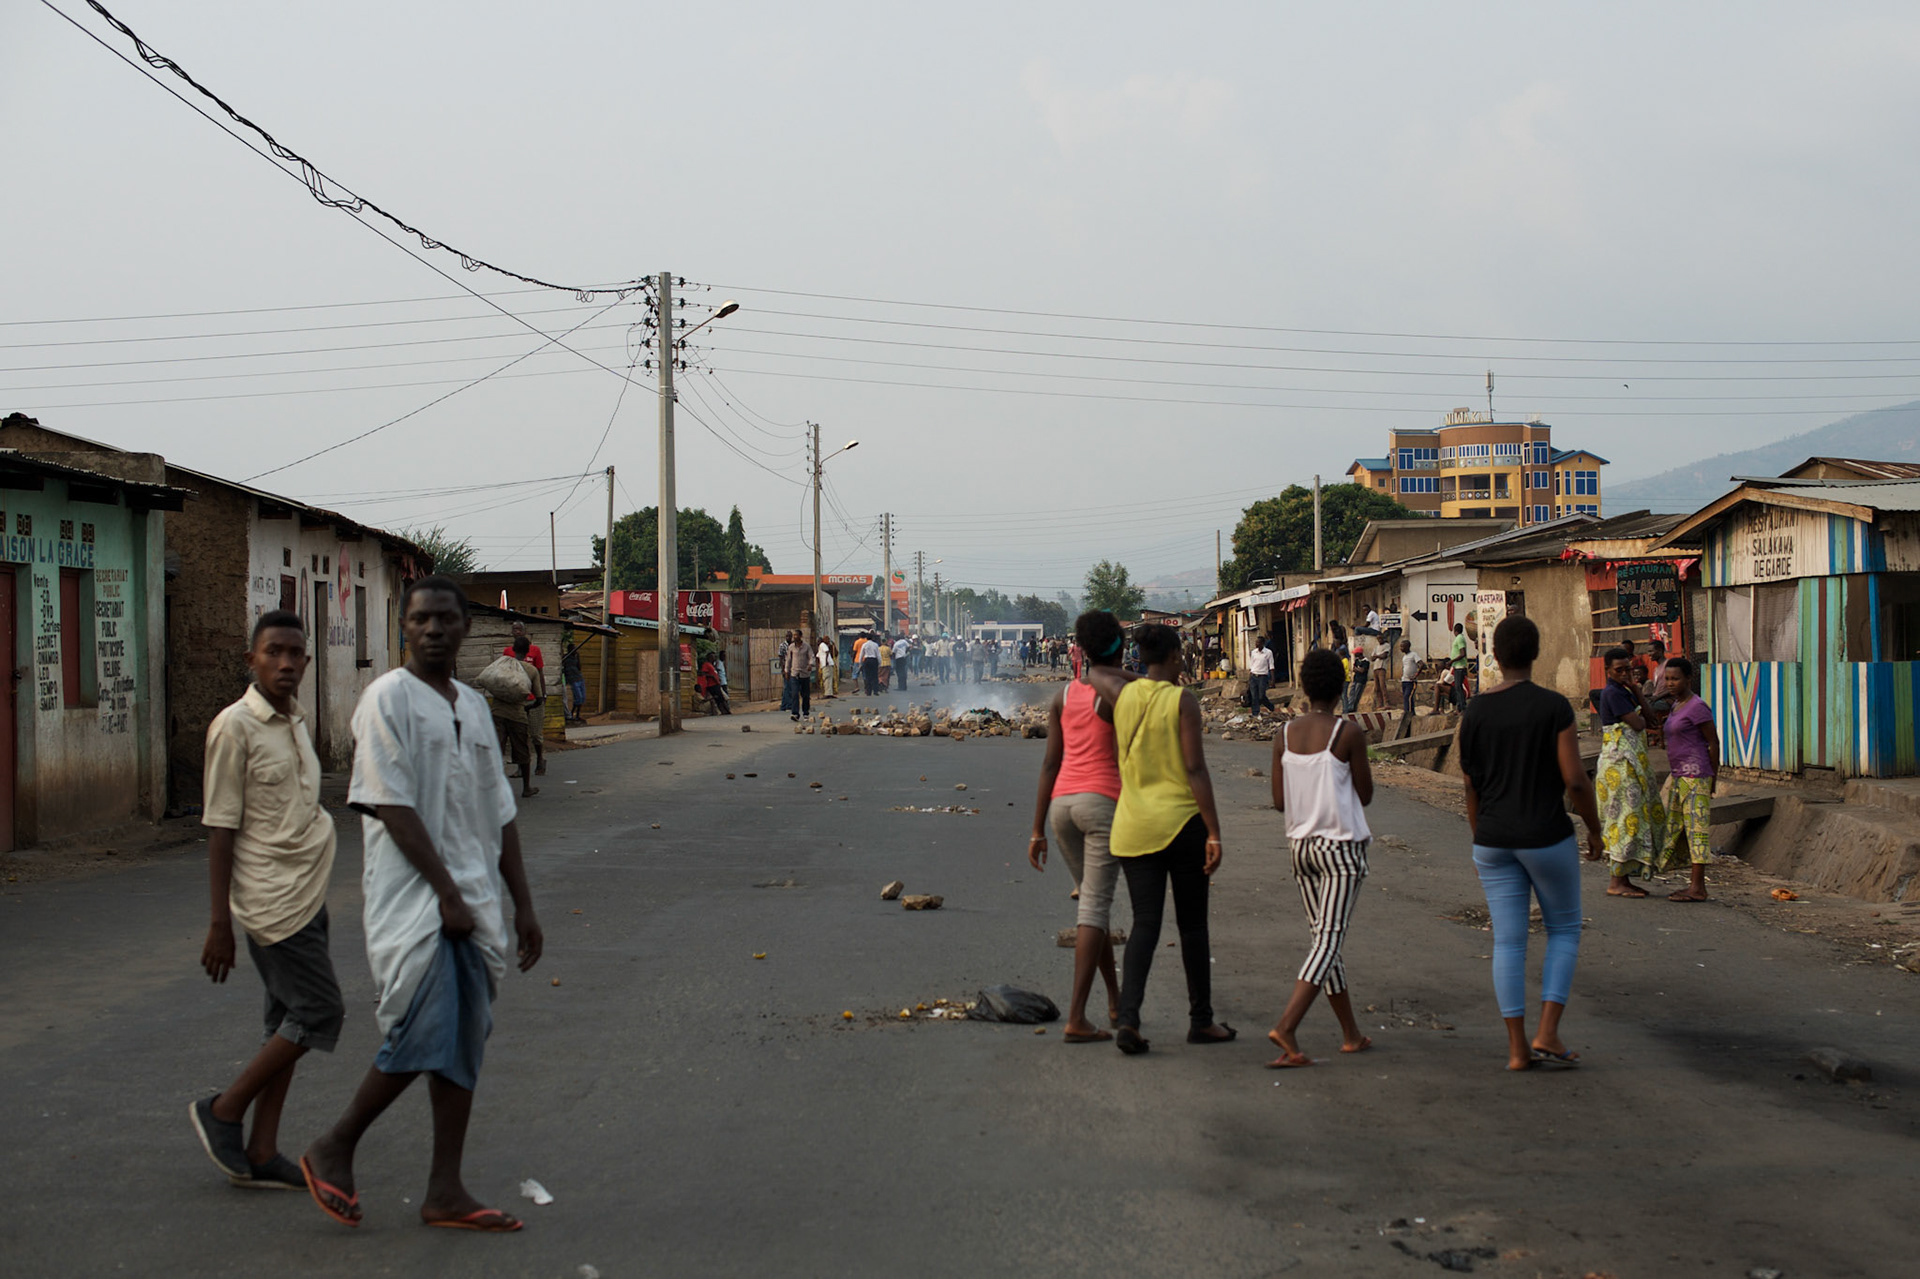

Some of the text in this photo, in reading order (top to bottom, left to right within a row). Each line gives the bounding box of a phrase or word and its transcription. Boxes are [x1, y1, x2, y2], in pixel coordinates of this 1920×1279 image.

[39, 537, 54, 564] LA
[58, 540, 94, 568] GRACE
[1754, 557, 1791, 577] DE GARDE
[96, 568, 128, 582] SECRETARIAT
[828, 575, 867, 584] MOGAS
[1432, 593, 1464, 603] GOOD
[1630, 602, 1668, 618] GARDE
